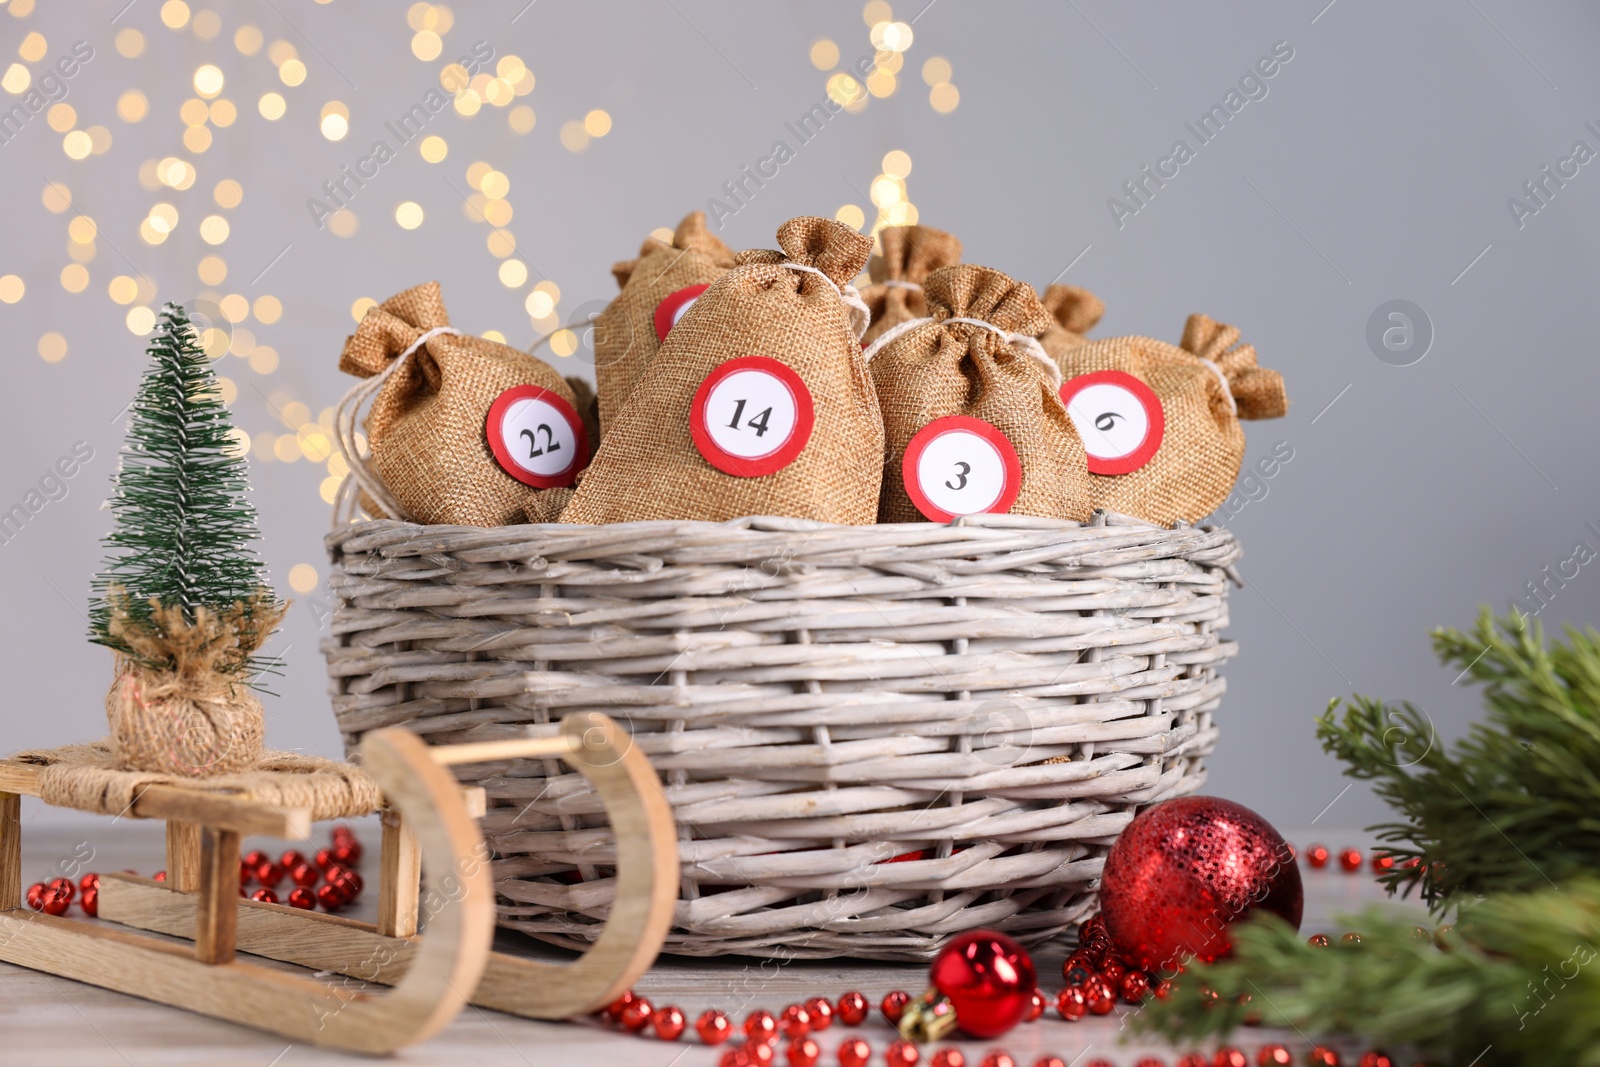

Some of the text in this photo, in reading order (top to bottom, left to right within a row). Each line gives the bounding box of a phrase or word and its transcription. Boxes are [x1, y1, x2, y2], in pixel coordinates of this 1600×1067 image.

[724, 399, 773, 438] 14
[1095, 412, 1127, 432] 6
[520, 423, 561, 459] 22
[945, 461, 971, 491] 3
